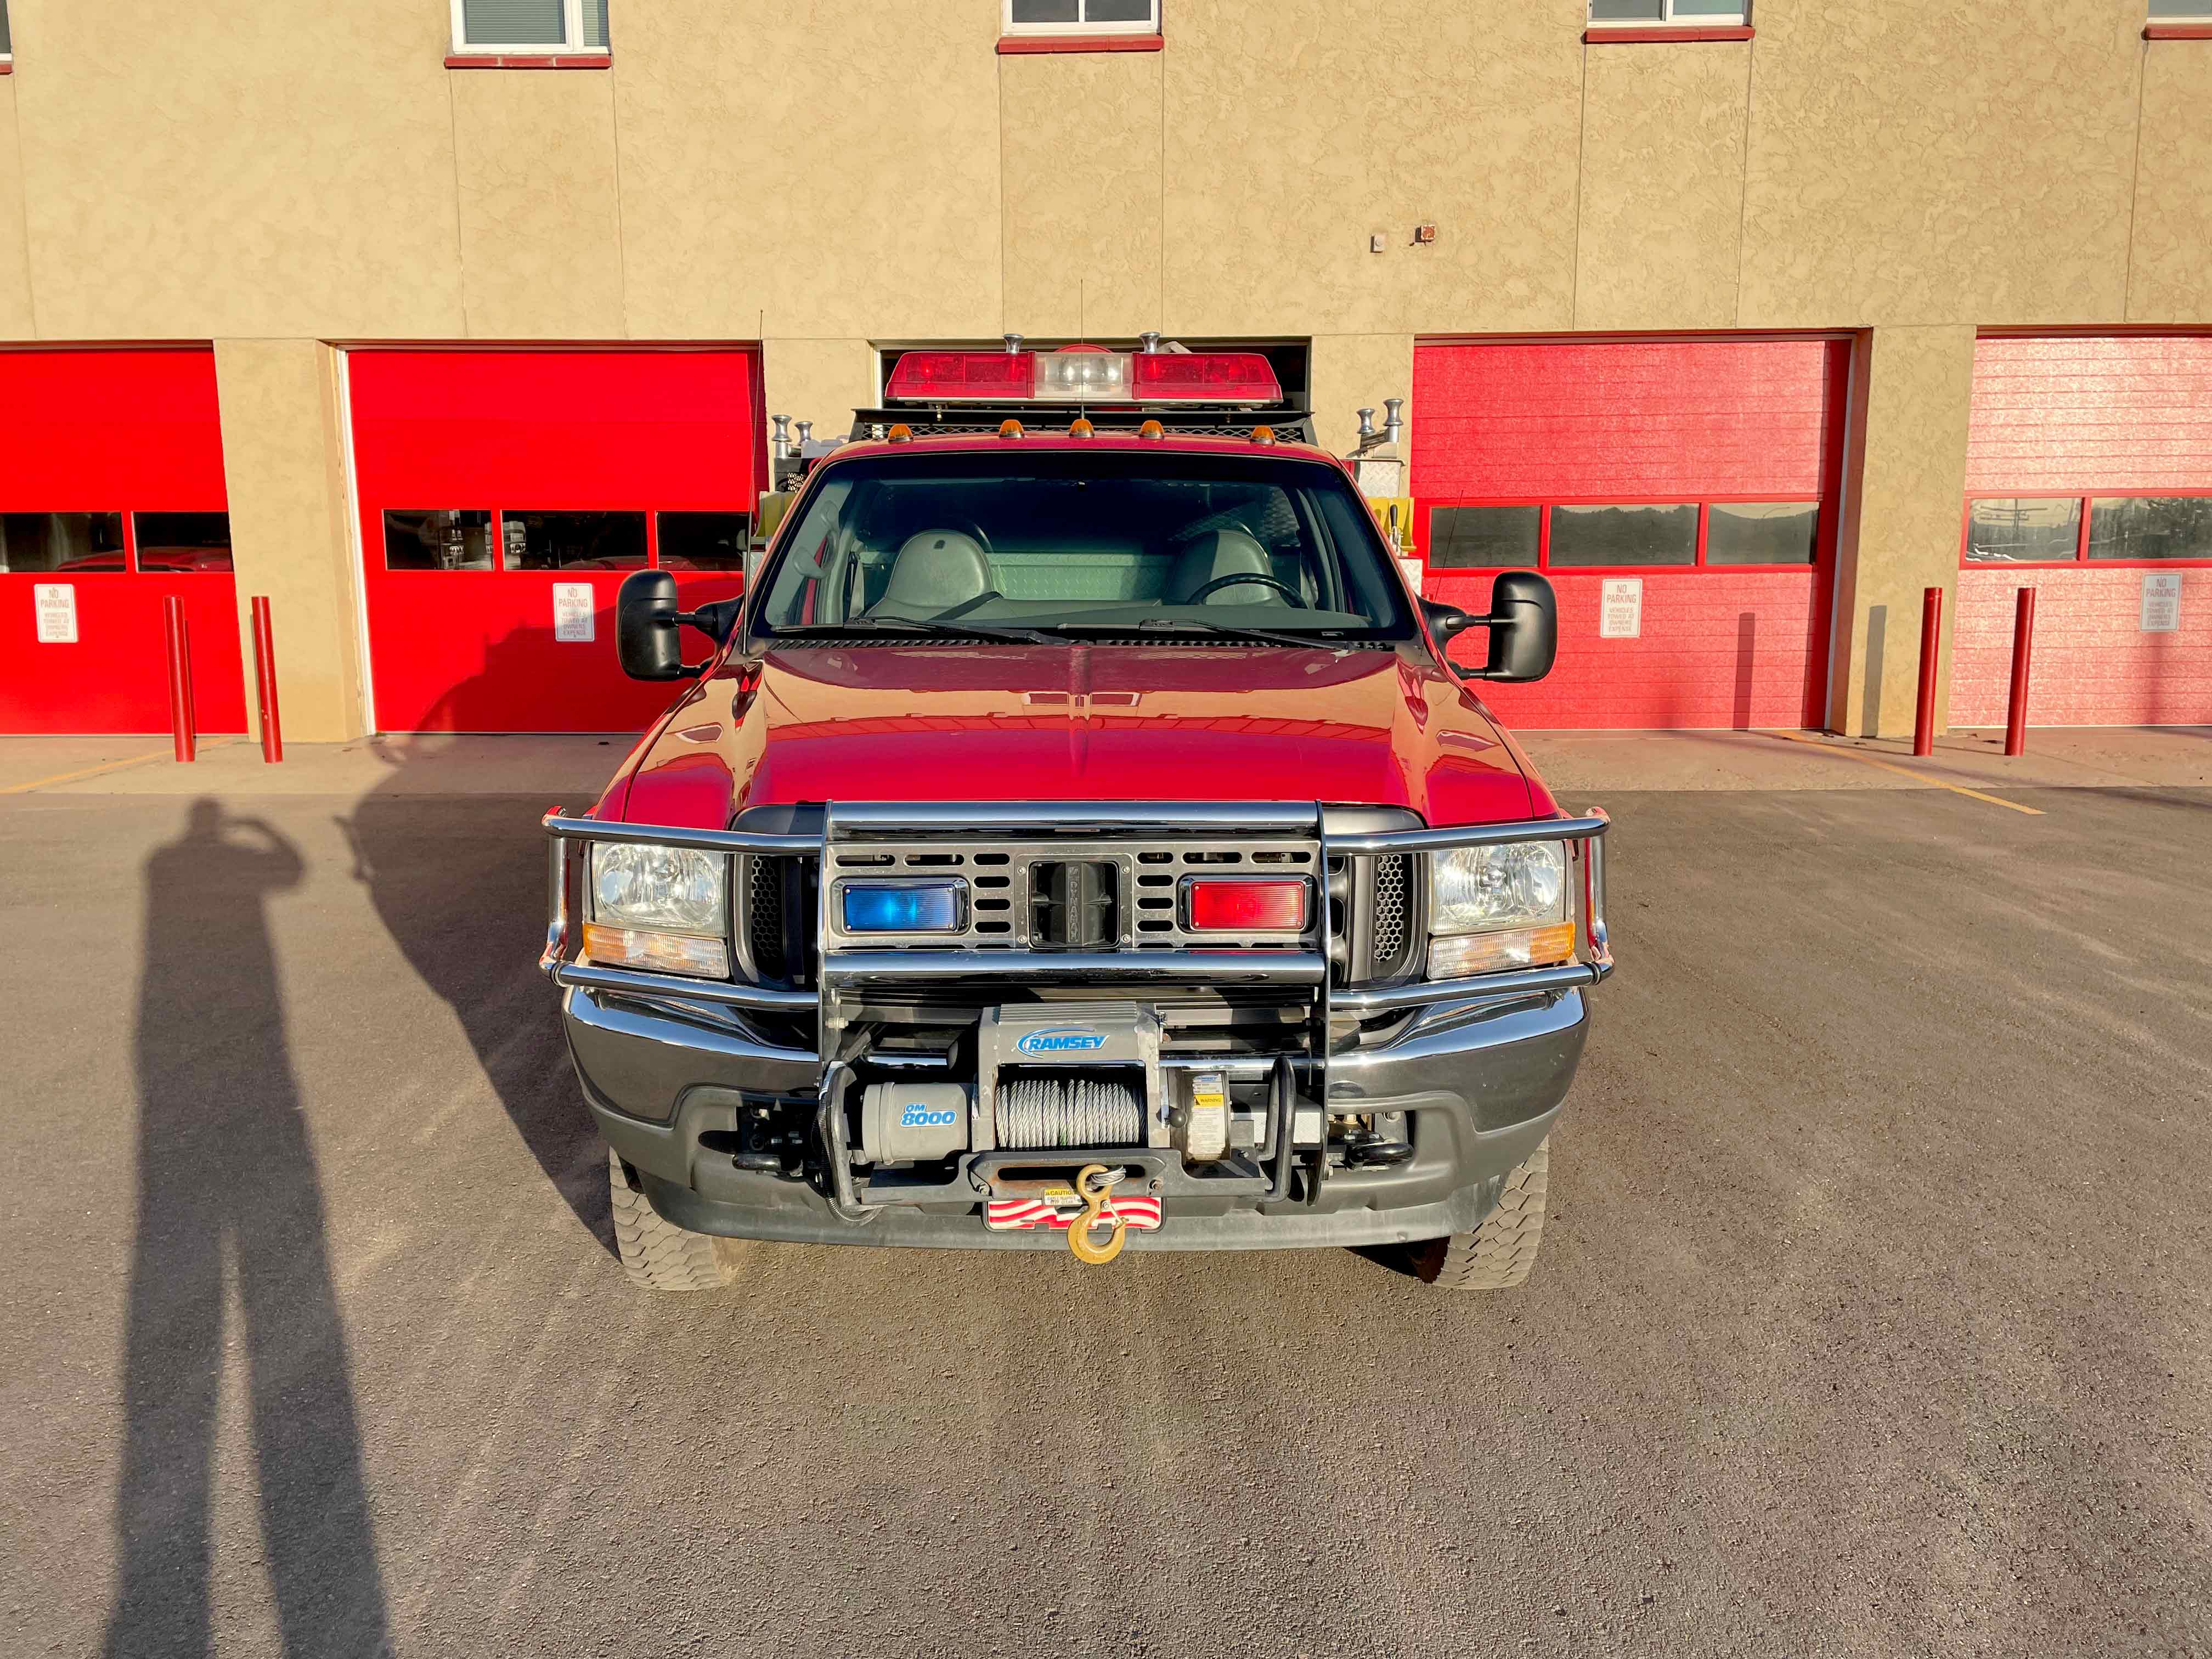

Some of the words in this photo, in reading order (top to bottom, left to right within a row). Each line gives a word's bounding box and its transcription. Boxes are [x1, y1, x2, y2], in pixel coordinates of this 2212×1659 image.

[2157, 579, 2166, 587] NO
[568, 588, 577, 597] NO
[1617, 584, 1627, 593] NO
[2146, 588, 2176, 597] PARKING
[49, 589, 58, 598] NO
[558, 599, 588, 607] PARKING
[1607, 594, 1637, 603] PARKING
[41, 600, 70, 608] PARKING
[1028, 1036, 1107, 1050] RAMSEY
[905, 1104, 926, 1112] QM
[901, 1111, 956, 1126] 8000
